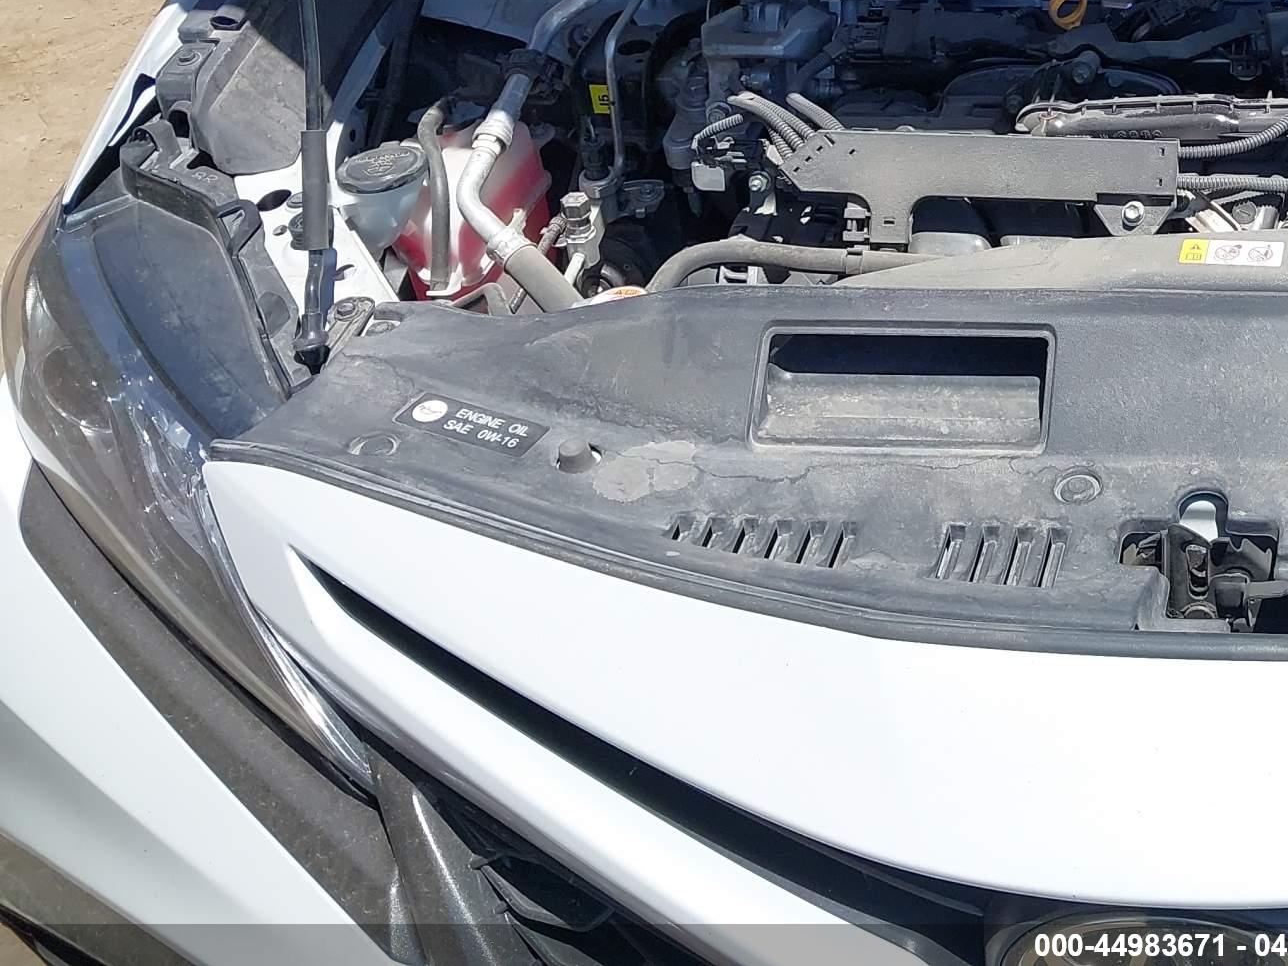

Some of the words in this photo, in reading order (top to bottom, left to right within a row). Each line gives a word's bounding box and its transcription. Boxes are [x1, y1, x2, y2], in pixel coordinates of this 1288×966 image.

[443, 419, 474, 434] SAE
[476, 429, 520, 448] 0W-16
[455, 408, 506, 429] ENGINE
[508, 423, 529, 437] OIL
